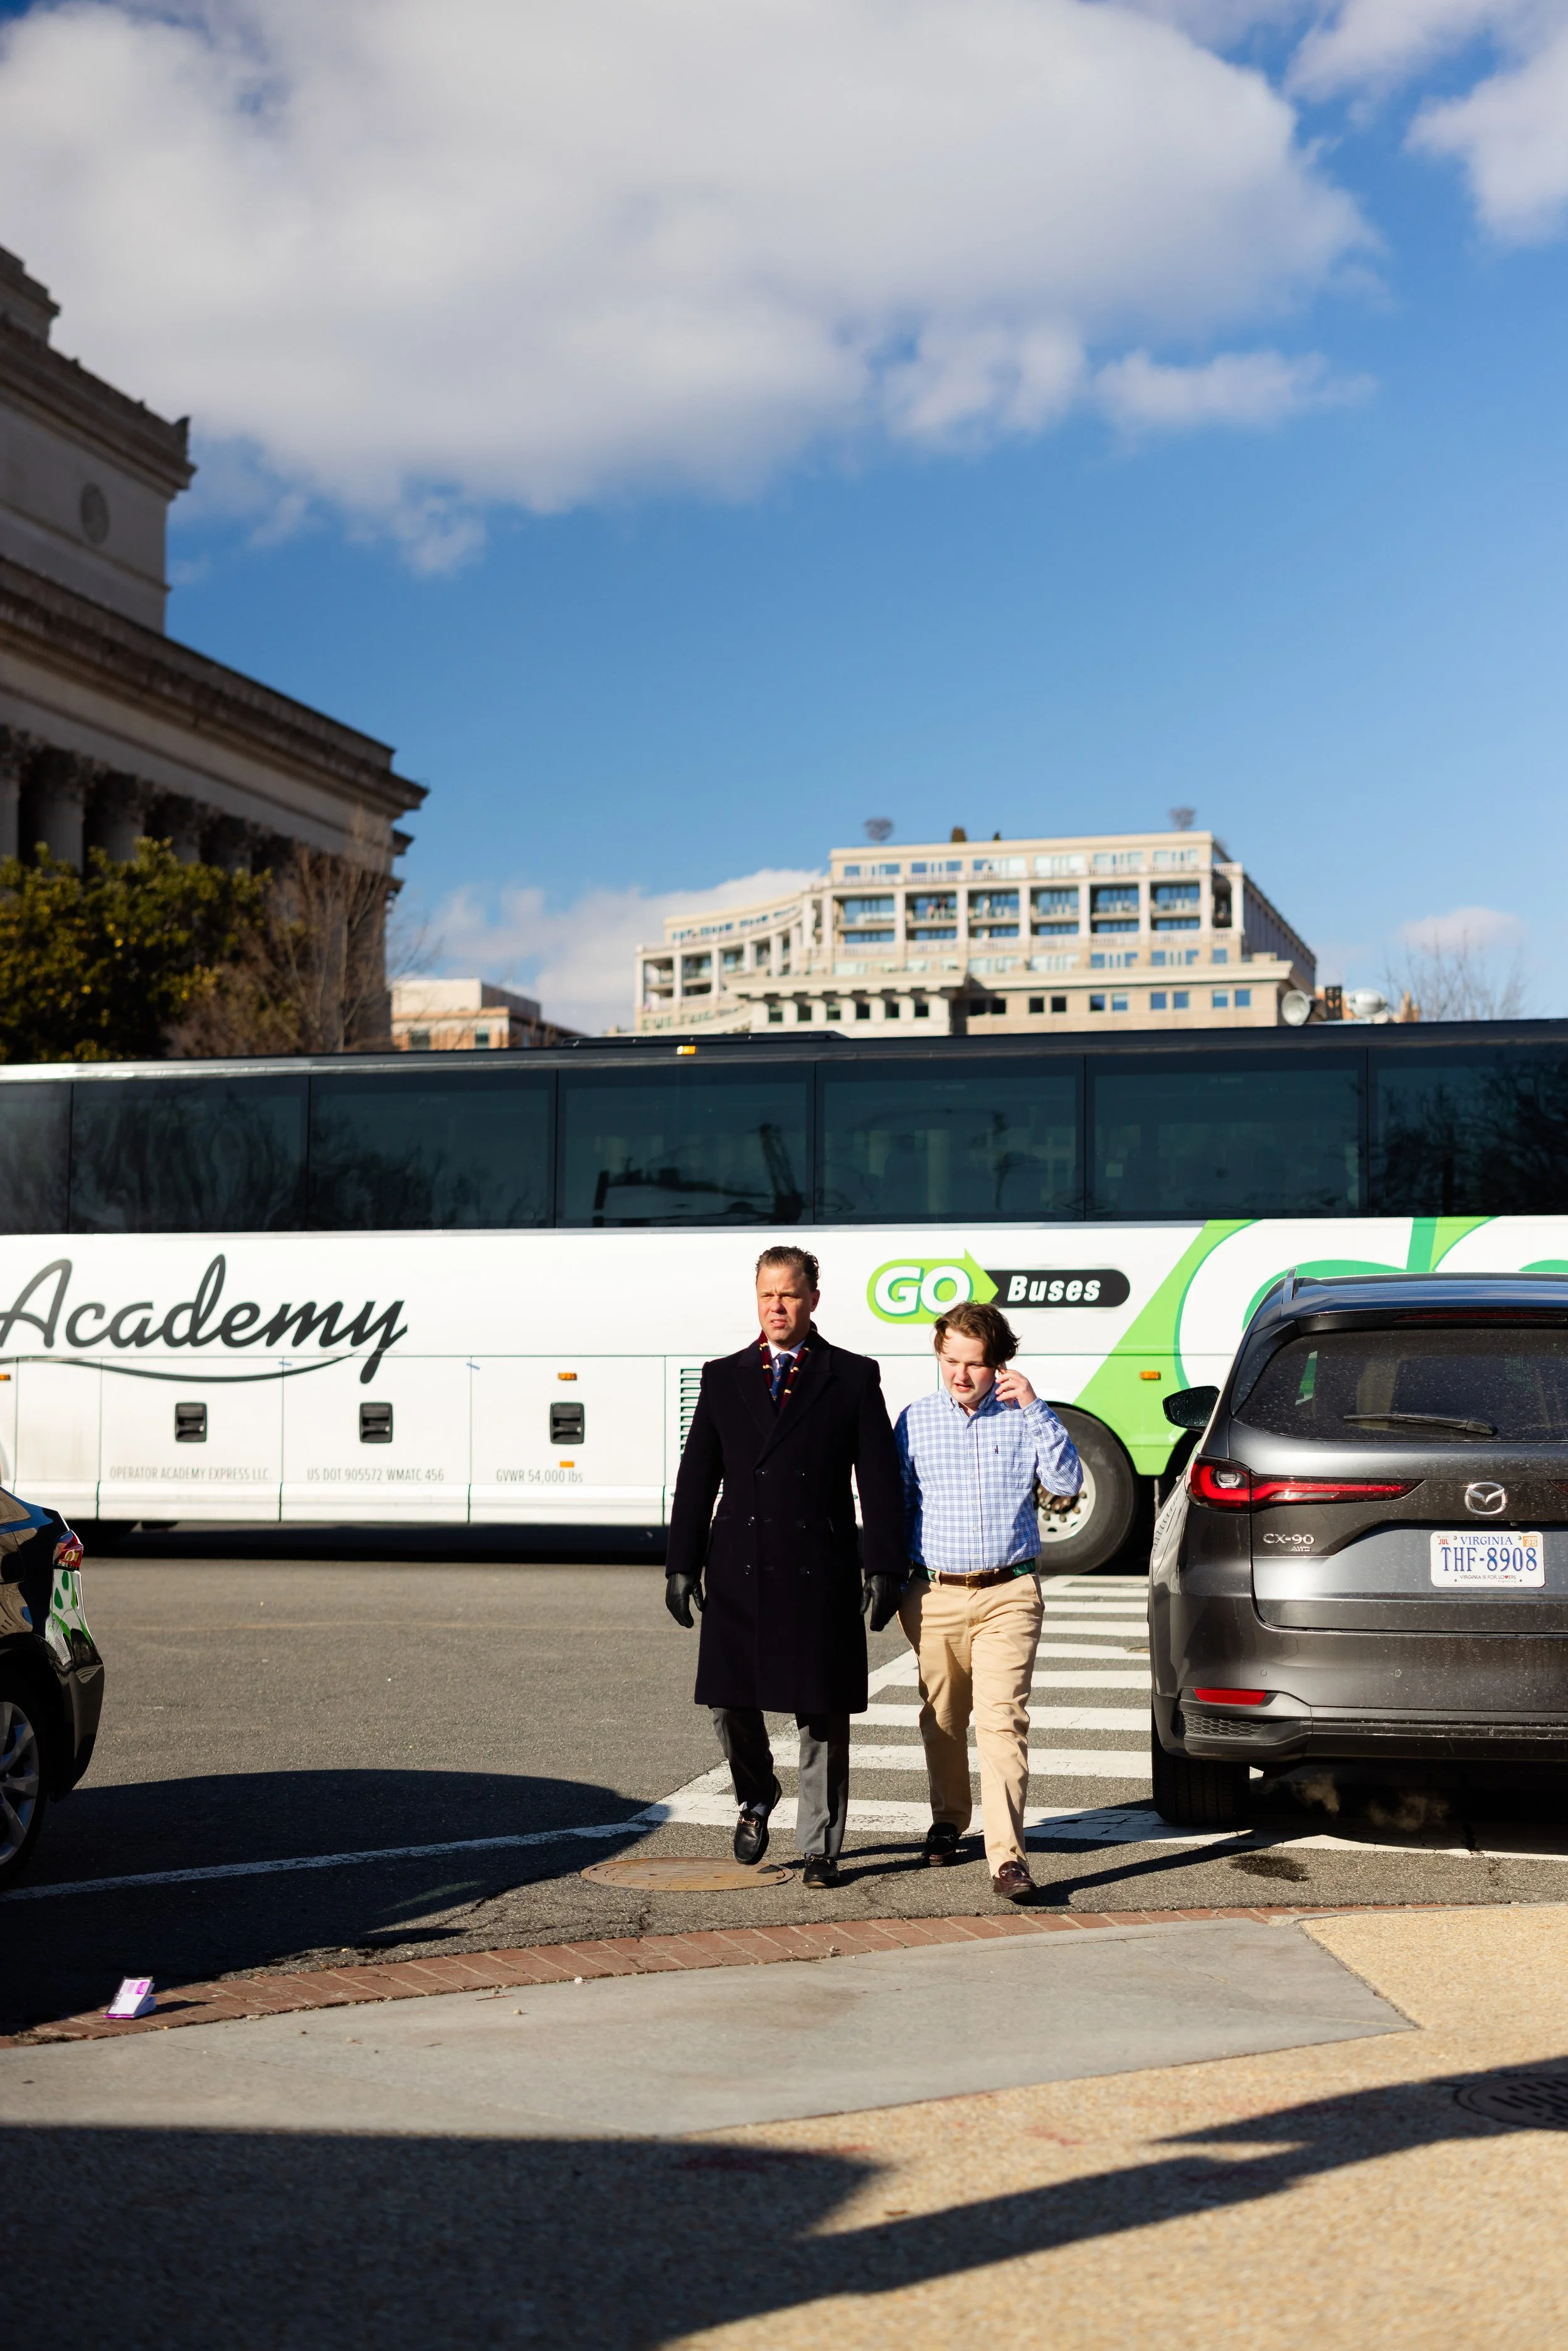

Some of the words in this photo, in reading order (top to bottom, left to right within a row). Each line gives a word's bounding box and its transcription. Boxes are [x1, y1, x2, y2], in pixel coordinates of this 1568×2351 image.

[874, 1265, 974, 1317] GO
[1007, 1275, 1101, 1303] Buses
[0, 1253, 408, 1384] Academy
[110, 1466, 159, 1480] OPERATOR
[161, 1466, 206, 1480] ACADEMY
[209, 1467, 250, 1481] EXPRESS
[307, 1468, 320, 1480] US
[323, 1468, 341, 1481] DOT
[345, 1468, 383, 1481] 905572
[386, 1468, 421, 1481] WMATC
[425, 1468, 444, 1481] 456
[496, 1469, 525, 1482] GVWR
[528, 1469, 565, 1484] 54,000
[568, 1470, 583, 1482] lbs
[1263, 1533, 1315, 1544] CX-90
[1460, 1536, 1513, 1545] VIRGINIA
[1441, 1547, 1537, 1572] THF-8908
